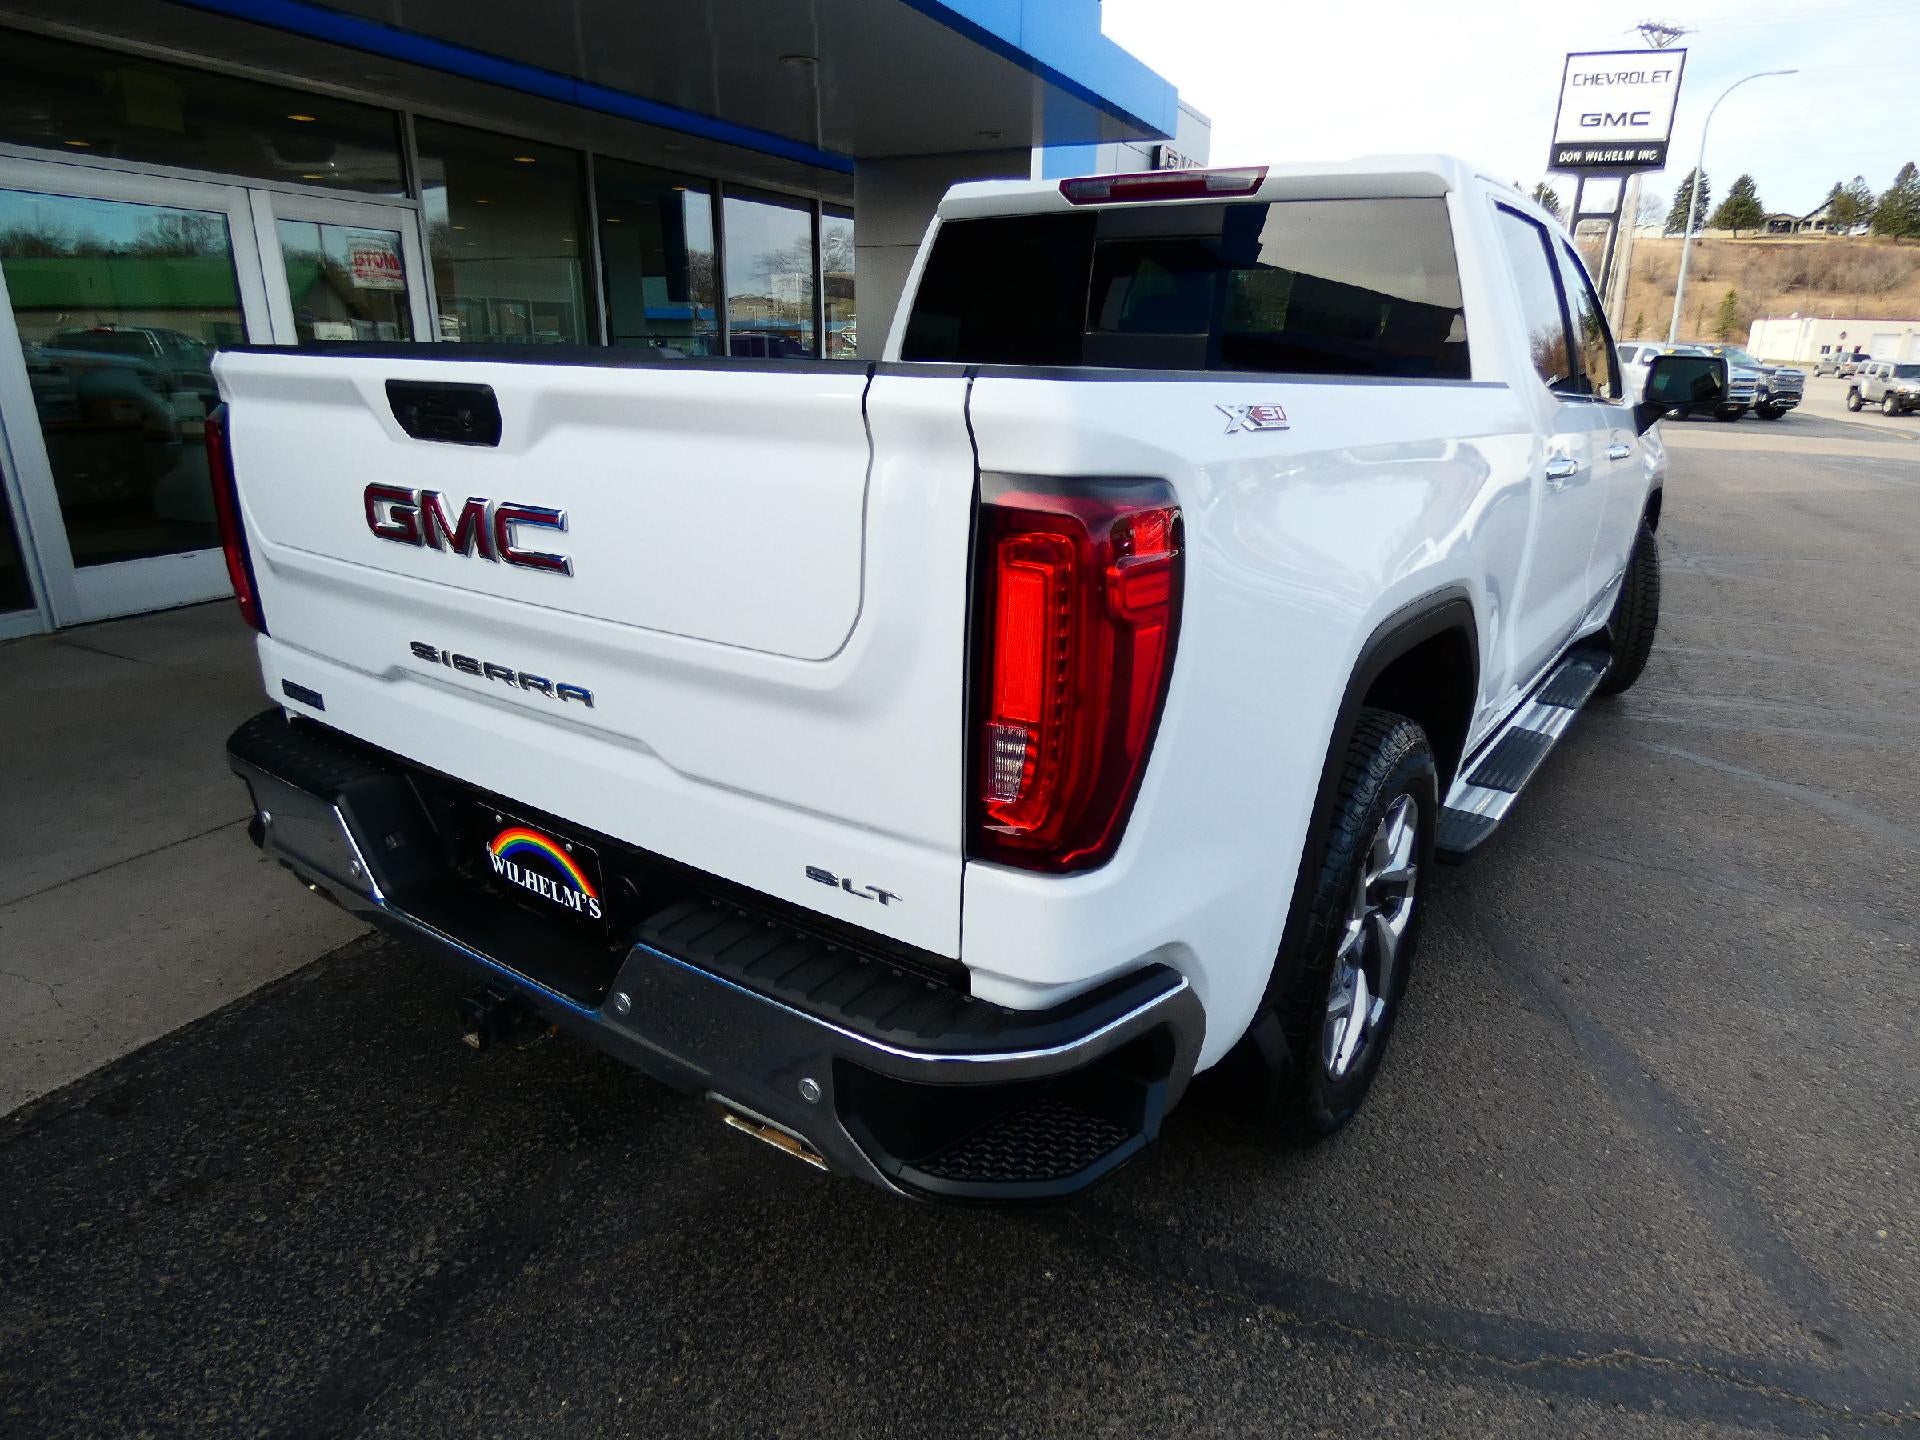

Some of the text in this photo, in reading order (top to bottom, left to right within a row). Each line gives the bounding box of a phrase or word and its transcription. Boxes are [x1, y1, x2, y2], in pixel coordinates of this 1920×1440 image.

[1572, 69, 1673, 87] CHEVROLET
[1580, 111, 1651, 127] GMC
[1558, 149, 1658, 162] DON WILHELM INC
[363, 481, 575, 578] GMC
[409, 641, 595, 708] SIERRA
[489, 852, 602, 919] WILHELM'S
[805, 865, 903, 906] SLT
